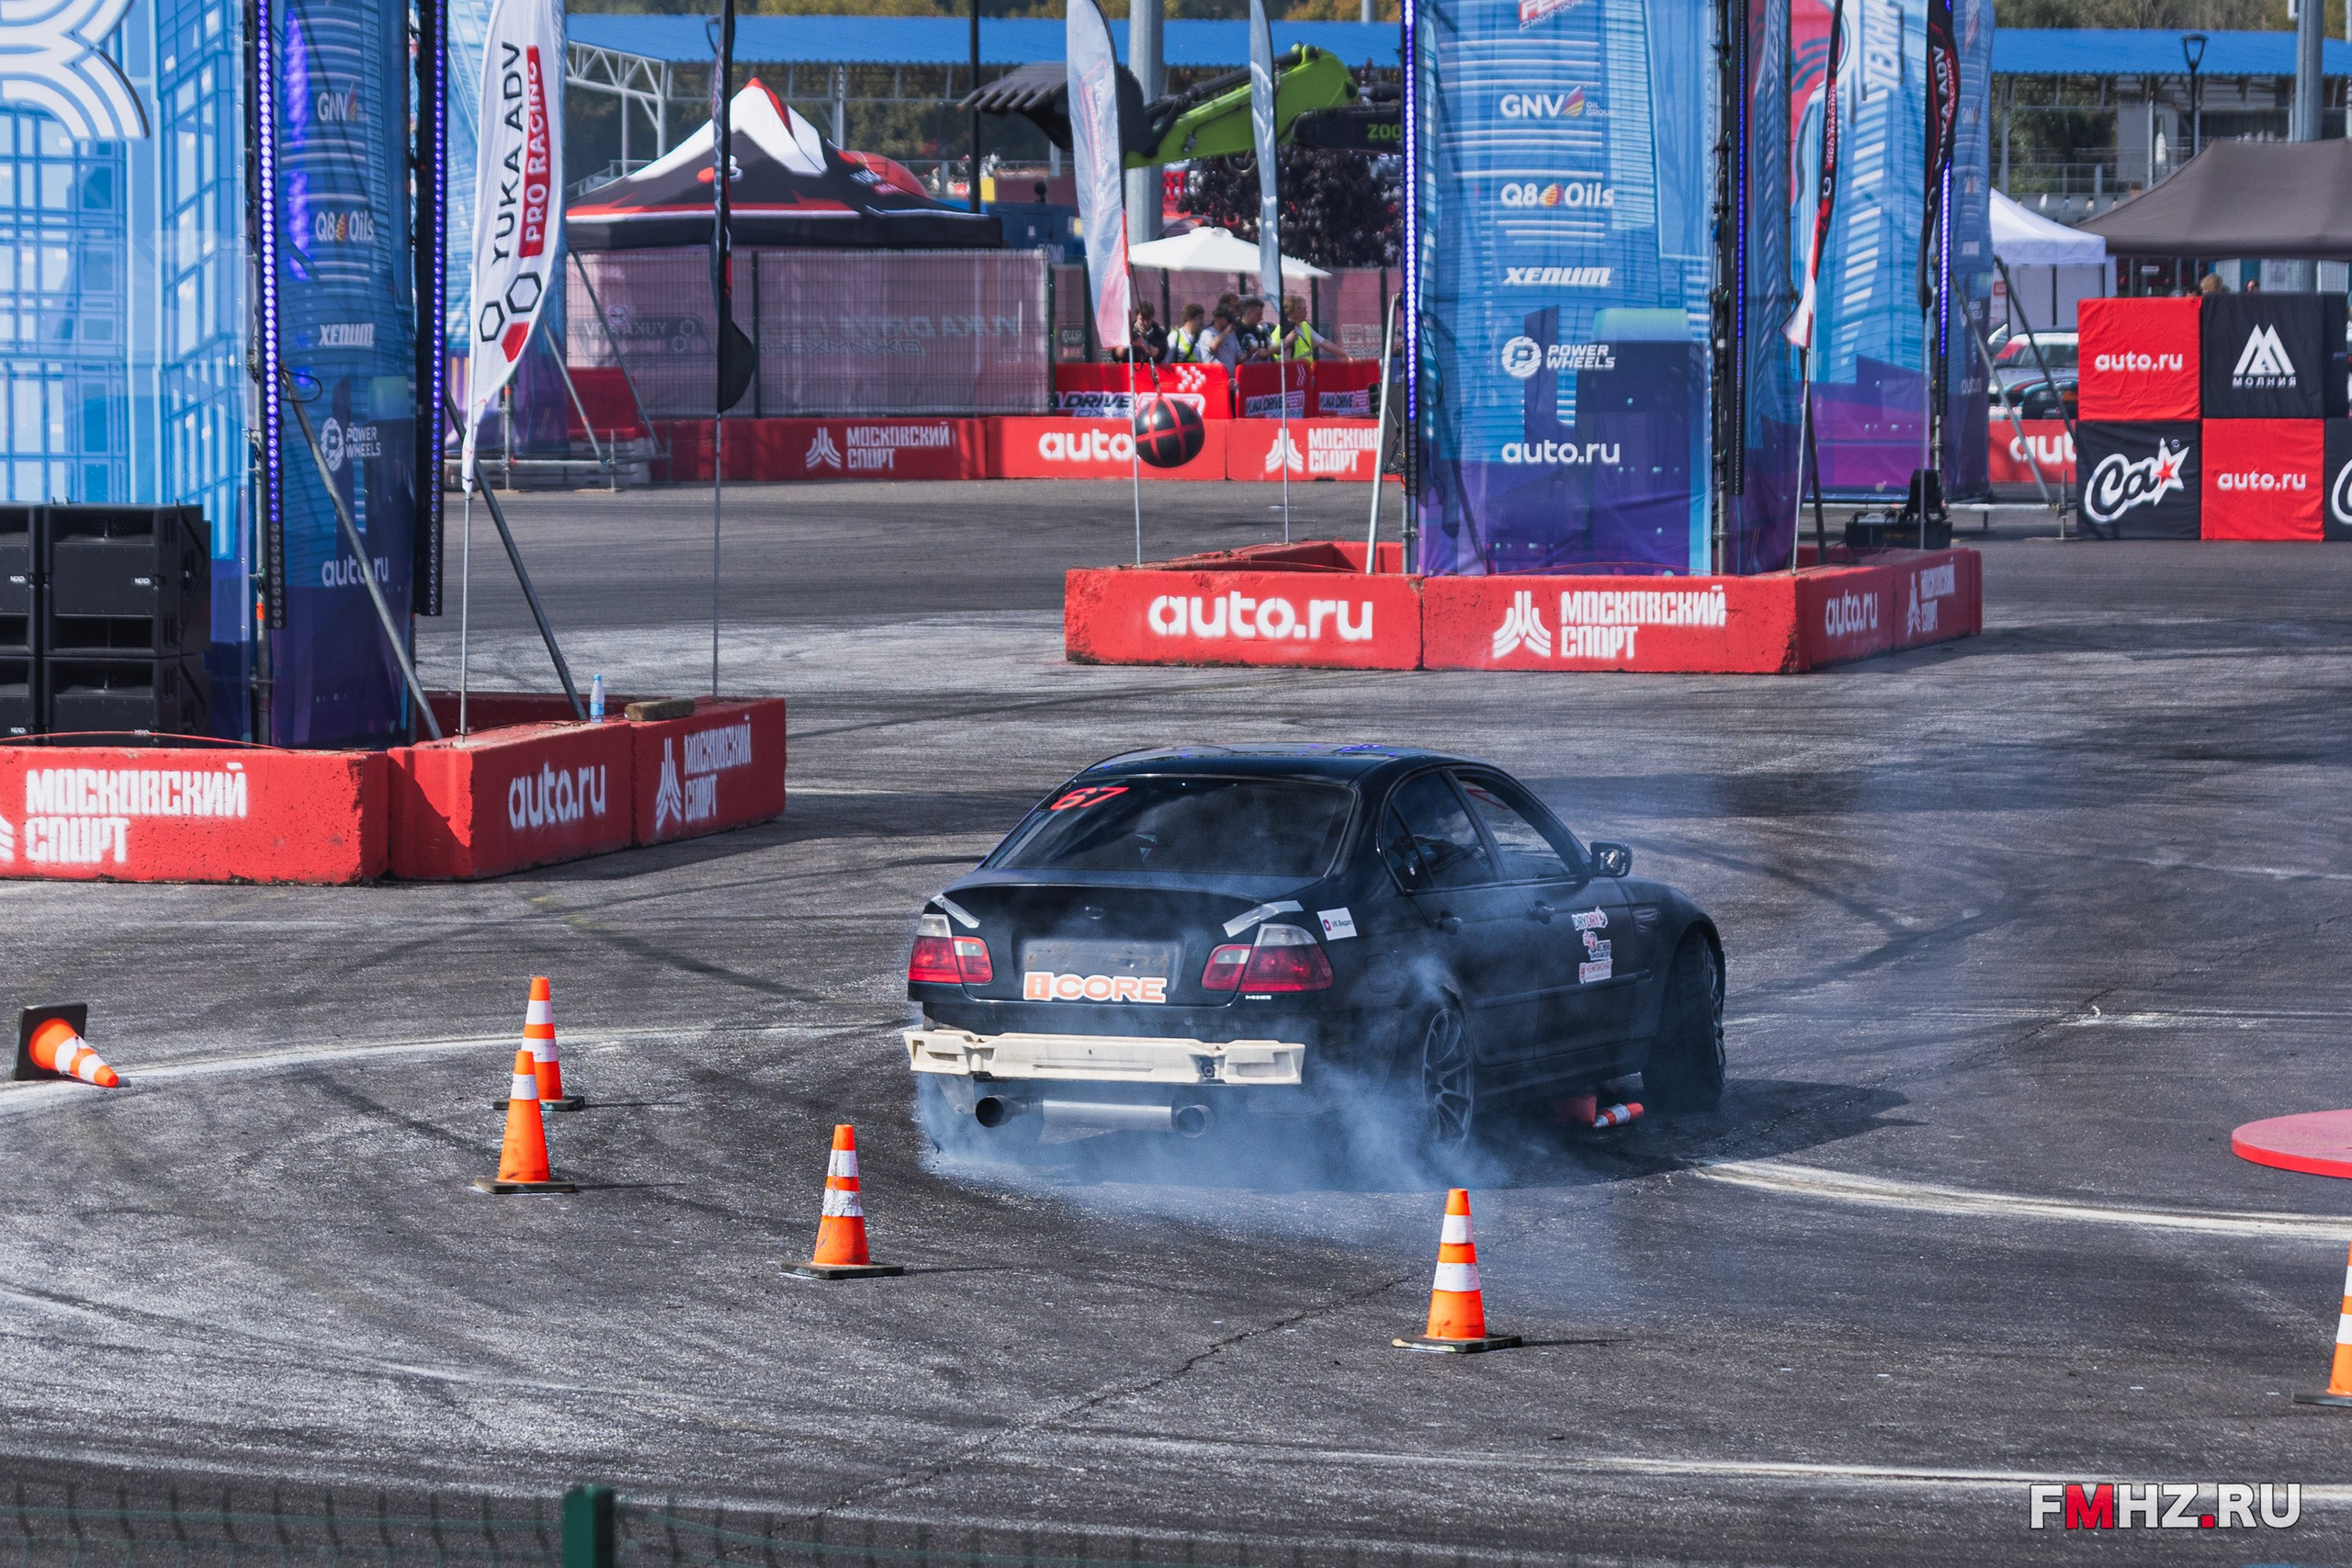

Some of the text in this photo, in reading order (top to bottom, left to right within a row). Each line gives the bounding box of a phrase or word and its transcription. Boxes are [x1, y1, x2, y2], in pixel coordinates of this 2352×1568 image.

[317, 91, 348, 121] GNV
[1500, 94, 1565, 118] GNV
[491, 39, 524, 266] YUKA ADV
[525, 60, 548, 244] PRO RACING
[1500, 182, 1615, 207] Q8 Oils
[315, 210, 375, 242] Q8 Oils
[1503, 267, 1611, 285] XENUM
[318, 323, 375, 346] XENUM
[1546, 356, 1616, 369] WHEELS
[1548, 344, 1610, 356] POWER
[2094, 351, 2184, 371] auto.ru
[2232, 376, 2297, 388] МОЛНИЯ
[345, 426, 378, 442] POWER
[846, 422, 950, 447] МОСКОВСКИЙ
[345, 442, 381, 457] WHEELS
[847, 447, 896, 468] СПОРТ
[1308, 449, 1359, 473] СПОРТ
[1502, 439, 1620, 464] auto.ru
[2217, 469, 2307, 491] auto.ru
[1148, 591, 1374, 640] auto.ru
[1560, 584, 1727, 626] МОСКОВСКИЙ
[1825, 589, 1878, 637] auto.ru
[1560, 625, 1639, 659] СПОРТ
[684, 714, 752, 776] МОСКОВСКИЙ
[26, 761, 247, 818] МОСКОВСКИЙ
[508, 761, 606, 829] auto.ru
[1050, 786, 1130, 810] 67
[25, 816, 130, 863] СПОРТ
